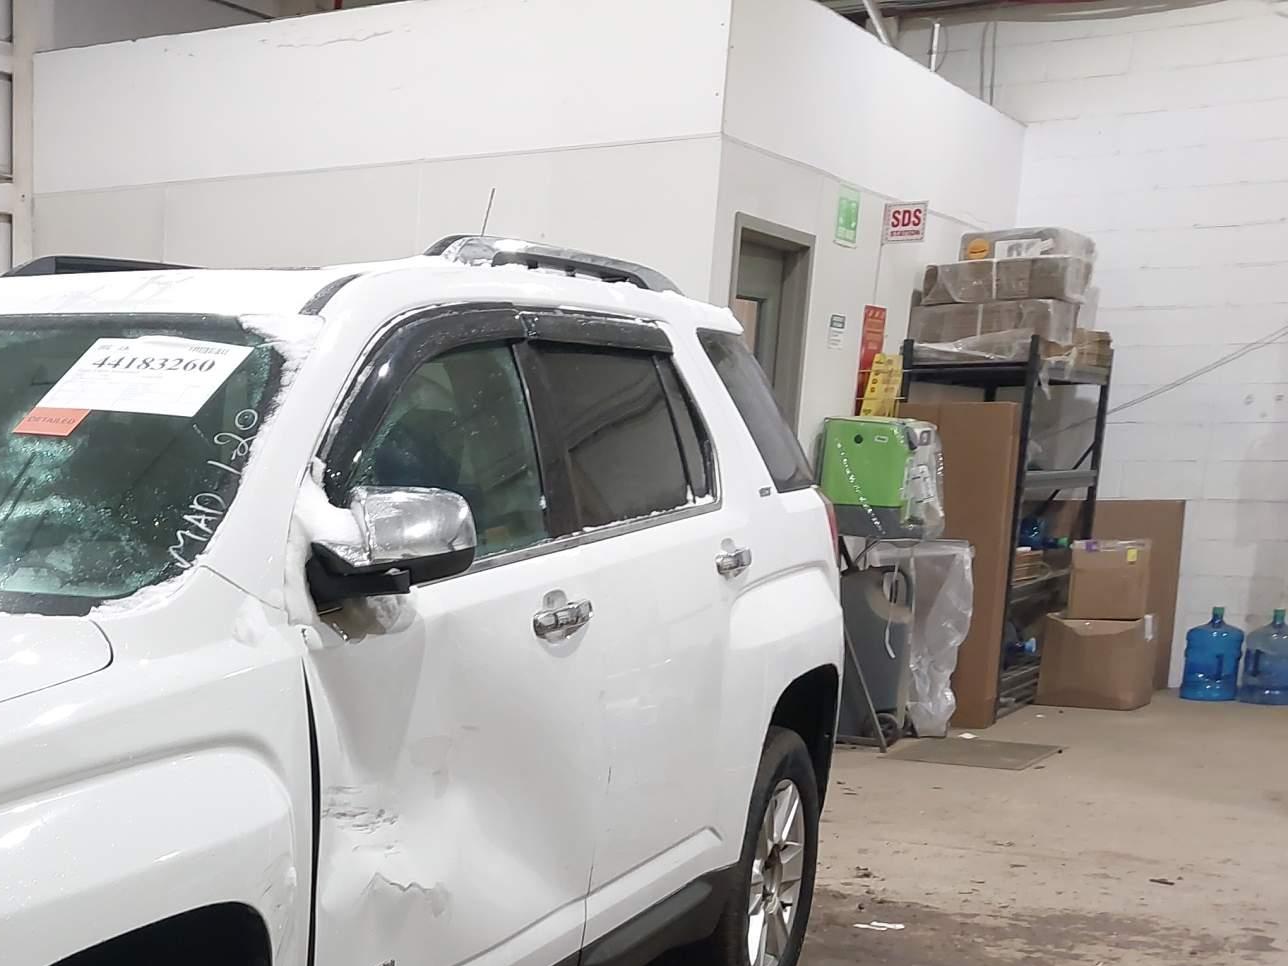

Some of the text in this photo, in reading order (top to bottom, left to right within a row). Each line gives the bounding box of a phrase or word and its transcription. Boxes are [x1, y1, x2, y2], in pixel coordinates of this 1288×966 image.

[890, 208, 922, 228] SDS
[92, 355, 216, 373] 44183260
[27, 416, 76, 425] DETAILED
[168, 492, 227, 569] MAD
